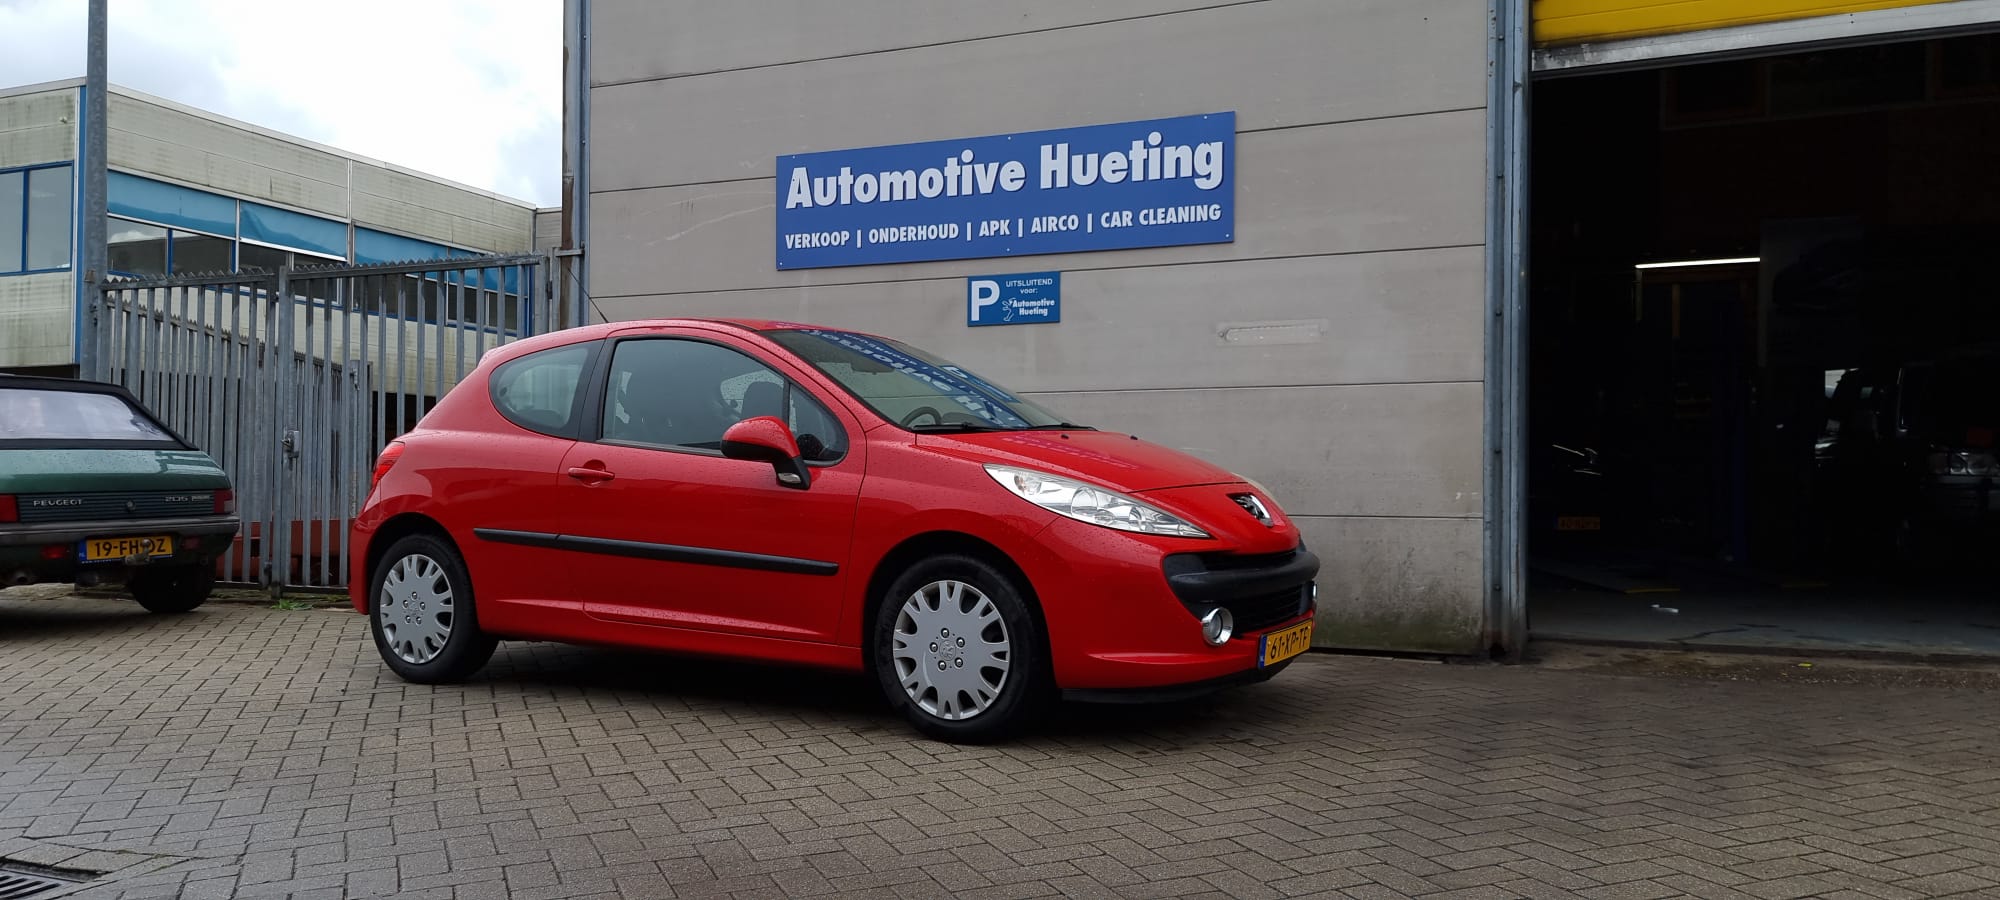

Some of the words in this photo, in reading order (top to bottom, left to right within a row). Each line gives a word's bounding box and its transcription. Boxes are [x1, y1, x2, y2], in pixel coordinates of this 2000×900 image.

[785, 149, 1026, 209] Automotive
[1040, 132, 1224, 190] Hueting
[785, 230, 850, 249] VERKOOP
[868, 223, 959, 243] ONDERHOUD
[979, 219, 1010, 237] APK
[1031, 214, 1079, 233] AIRCO
[1101, 211, 1133, 229] CAR
[1139, 204, 1222, 226] CLEANING
[1005, 278, 1053, 287] UITSLUITEND
[971, 280, 1000, 321] P
[1012, 298, 1055, 308] Automotive
[1019, 306, 1048, 317] Hueting
[33, 498, 82, 507] PEUGEOT
[1270, 626, 1309, 660] 61-XP-TF
